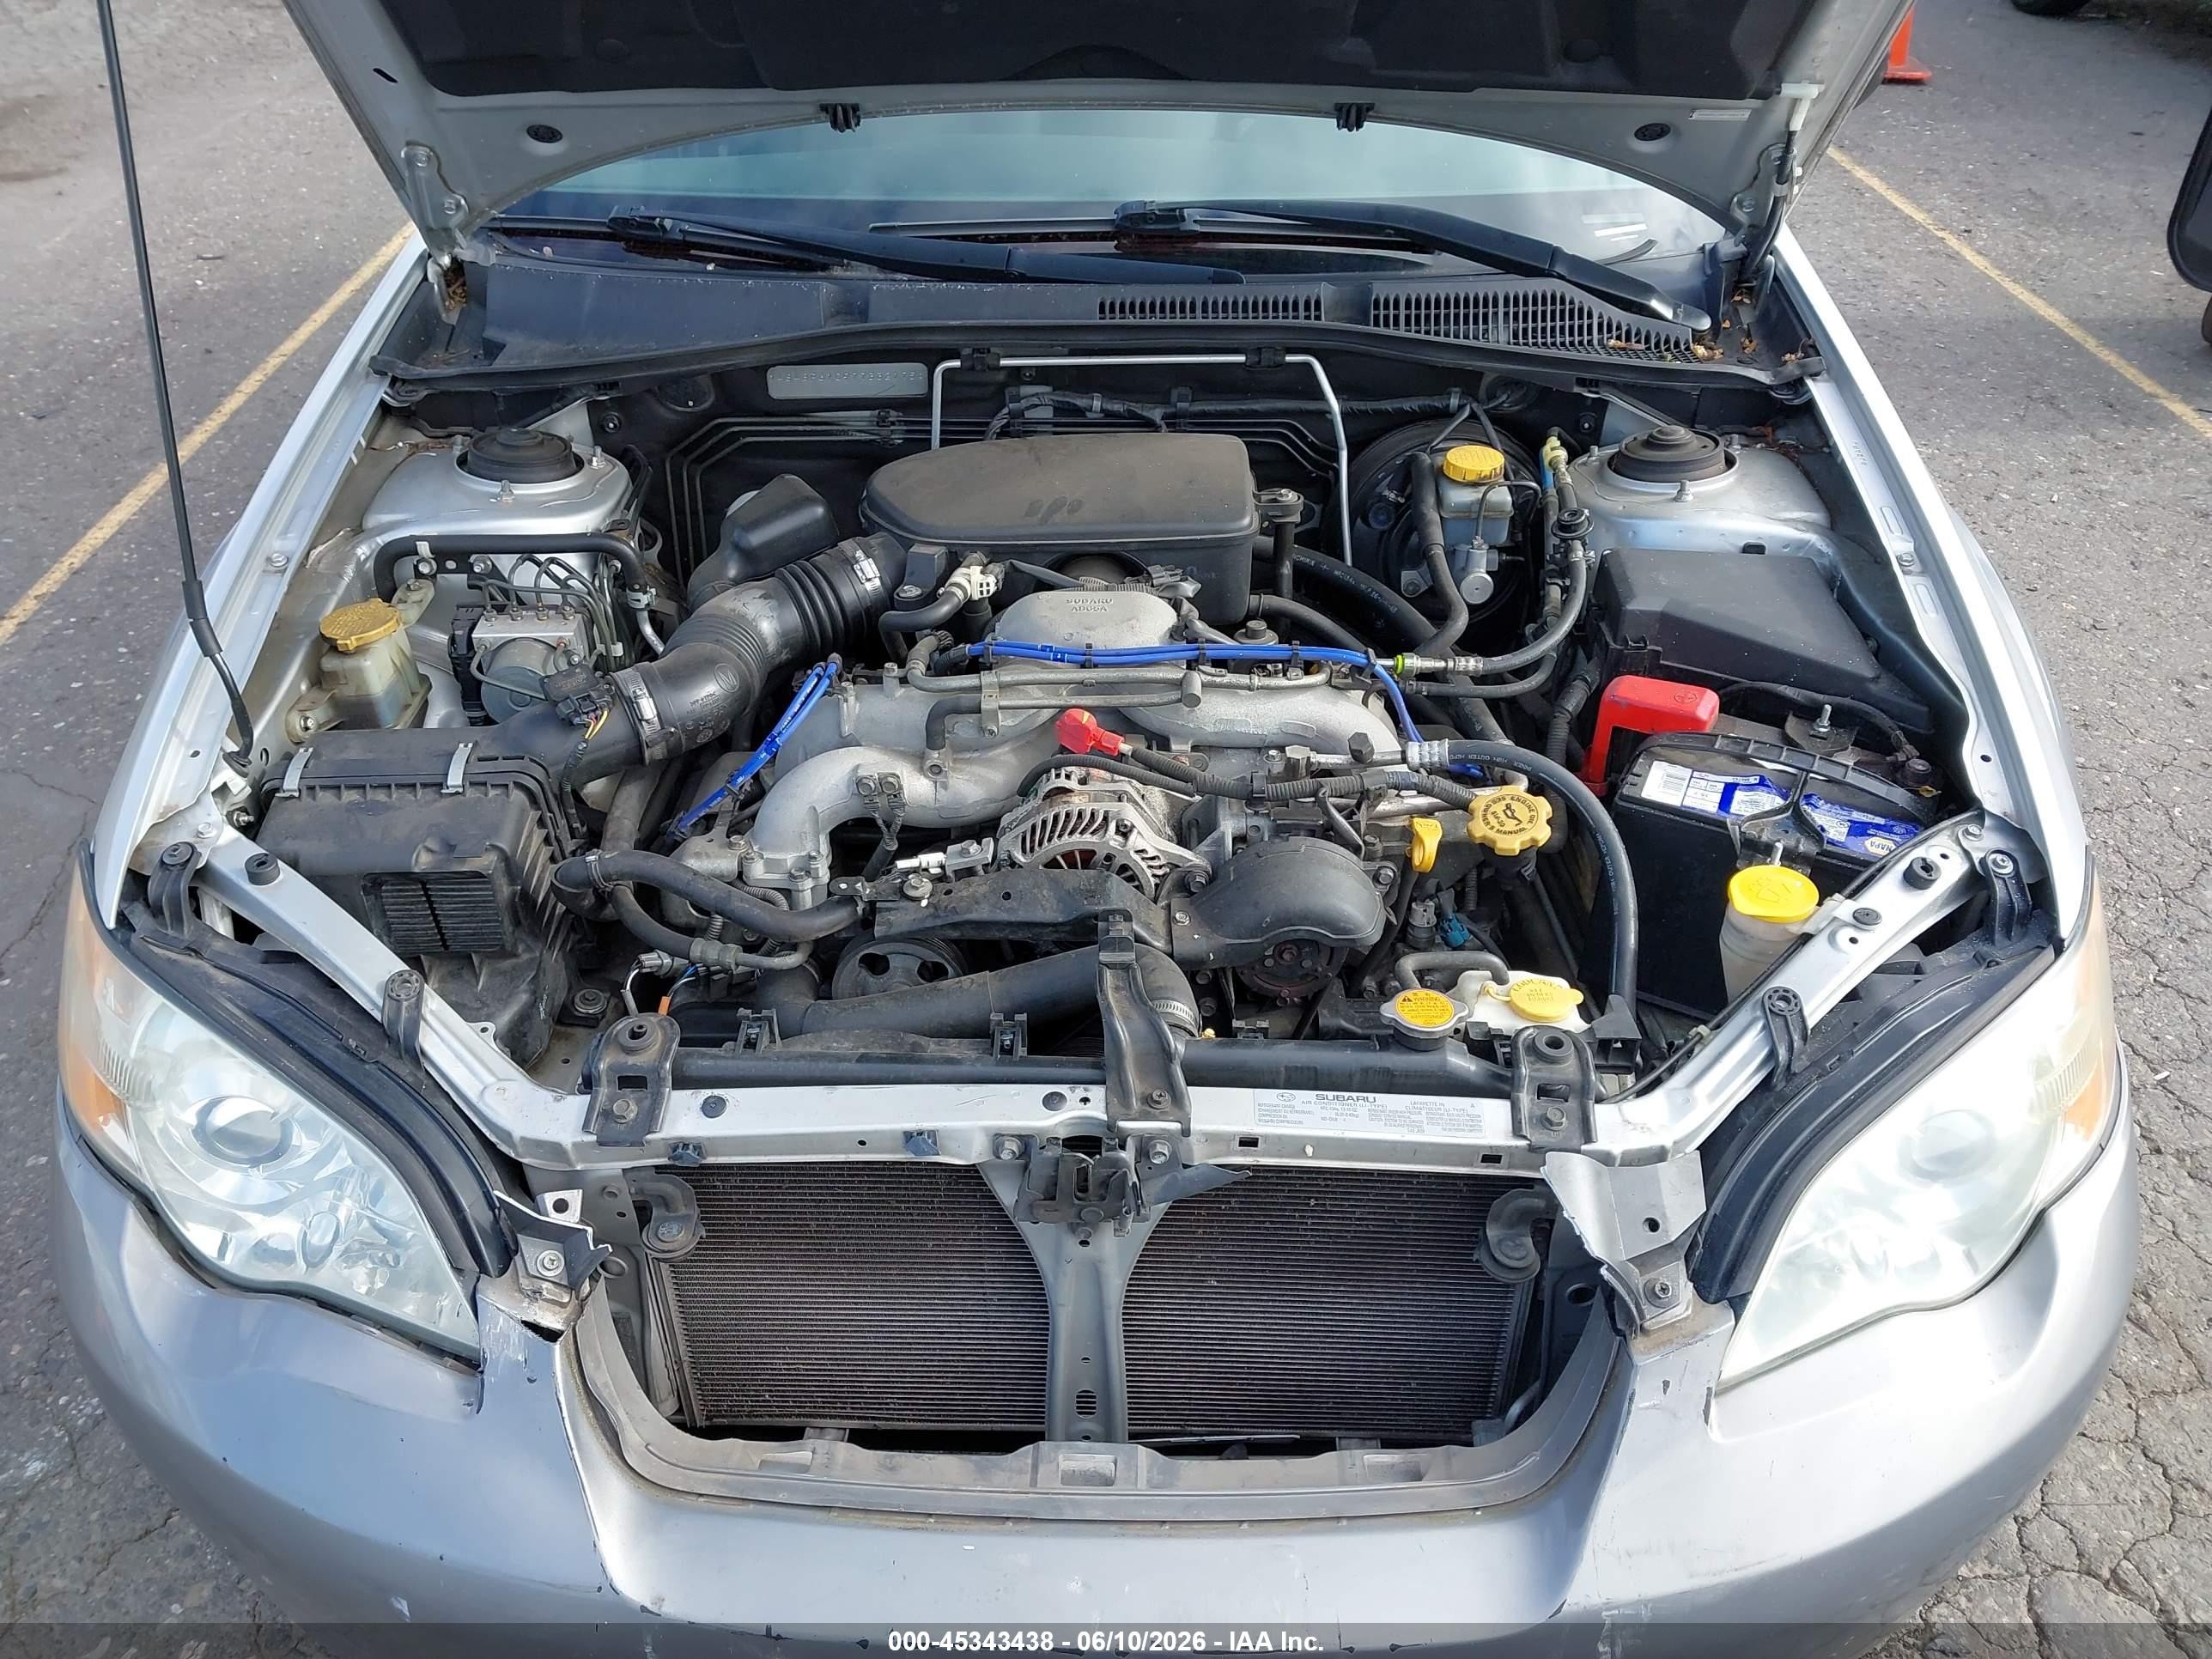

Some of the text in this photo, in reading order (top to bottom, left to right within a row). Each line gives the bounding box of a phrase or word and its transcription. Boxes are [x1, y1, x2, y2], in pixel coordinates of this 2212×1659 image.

[1510, 796, 1536, 824] ENGINE OIL
[1496, 827, 1528, 836] MANUAL
[1869, 840, 1895, 854] NAPA
[1315, 1093, 1376, 1103] SUBARU
